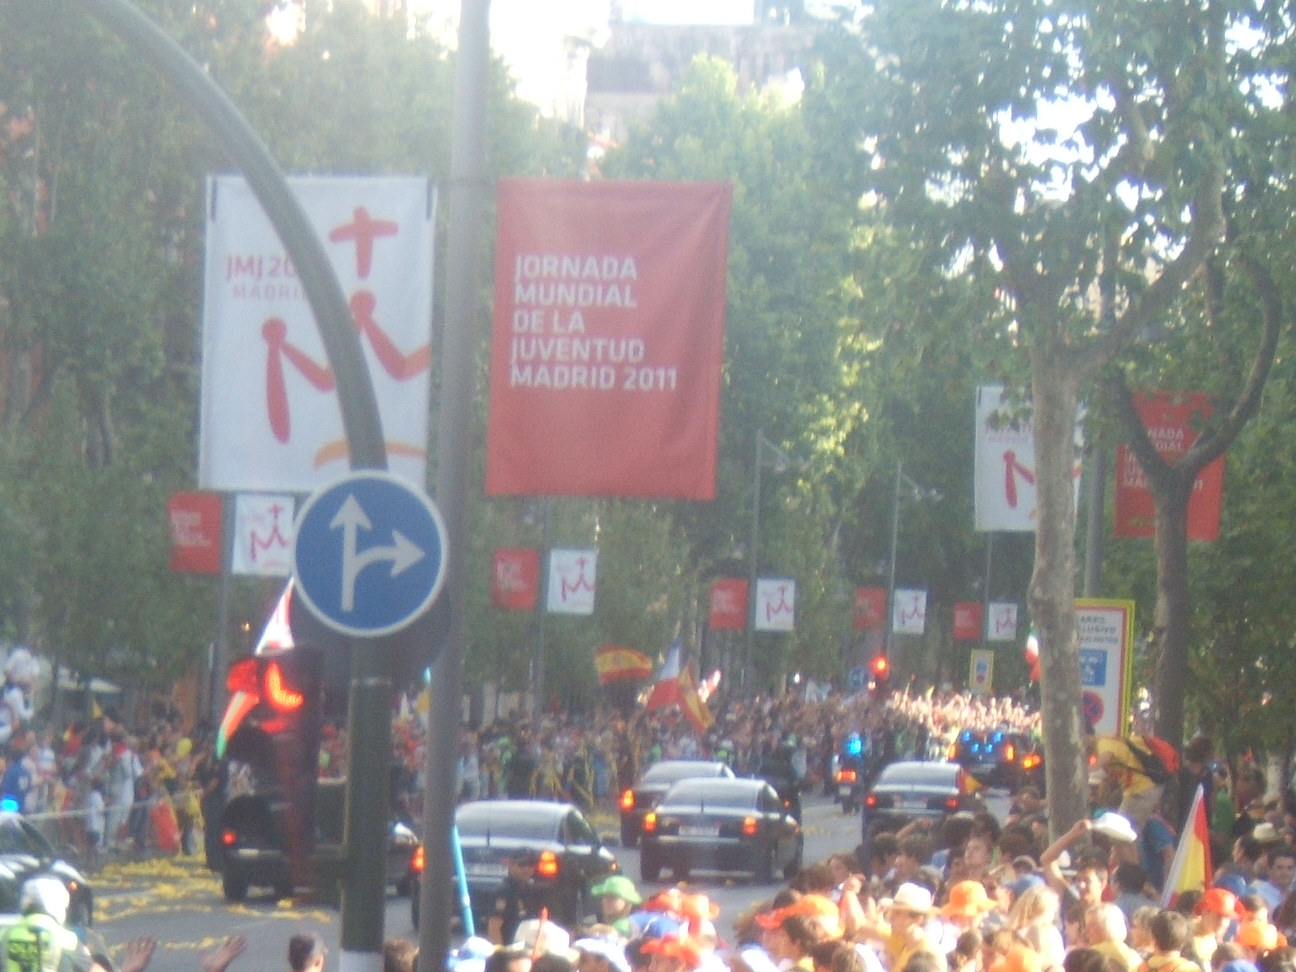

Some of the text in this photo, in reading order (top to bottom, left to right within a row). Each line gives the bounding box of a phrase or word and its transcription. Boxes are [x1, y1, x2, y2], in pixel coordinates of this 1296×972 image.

[227, 255, 299, 281] JMJ 20
[515, 255, 638, 281] JORNADA
[233, 284, 304, 300] MADRI
[515, 283, 638, 308] MUNDIAL
[513, 310, 585, 334] DE LA
[511, 337, 645, 365] JUVENTUD
[510, 364, 678, 392] MADRID 2011
